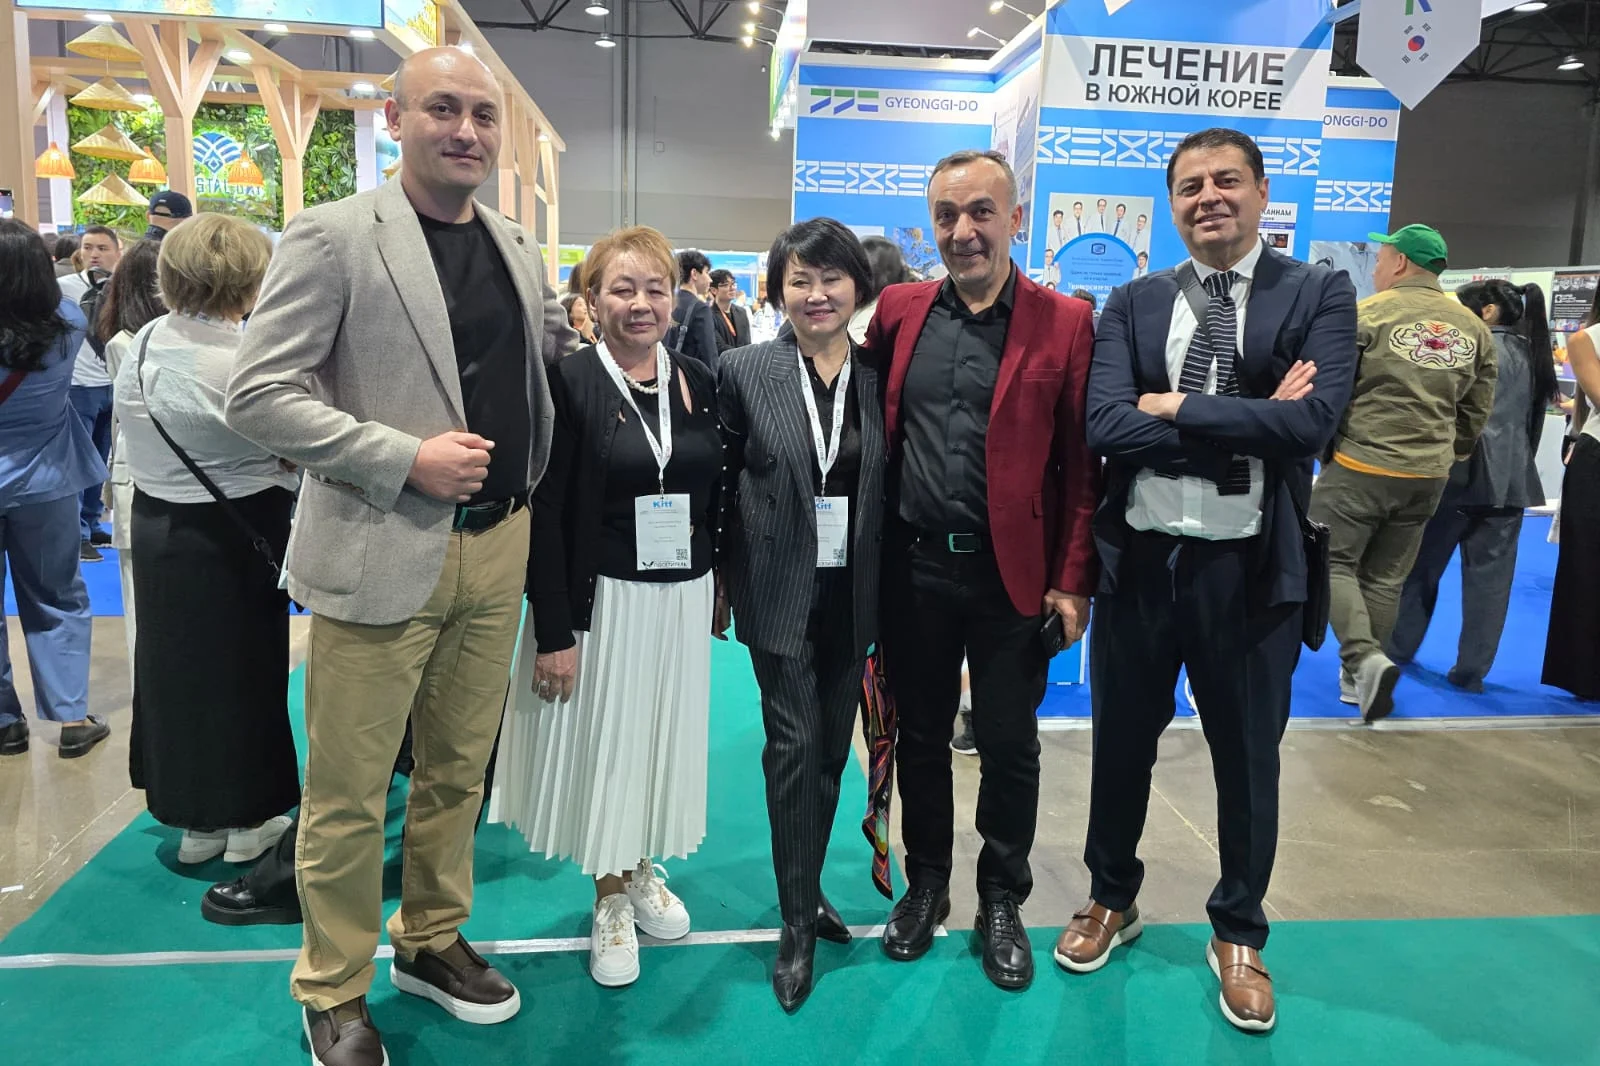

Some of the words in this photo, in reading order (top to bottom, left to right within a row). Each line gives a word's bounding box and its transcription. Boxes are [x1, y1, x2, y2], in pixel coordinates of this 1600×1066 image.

[1088, 43, 1286, 86] ЛЕЧЕНИЕ
[885, 96, 979, 112] GYEONGGI-DO
[1085, 82, 1100, 101] В
[1108, 83, 1200, 107] ЮЖНОЙ
[1207, 88, 1283, 111] КОРЕЕ
[1323, 114, 1388, 128] ONGGI-DO
[196, 177, 230, 194] STAL
